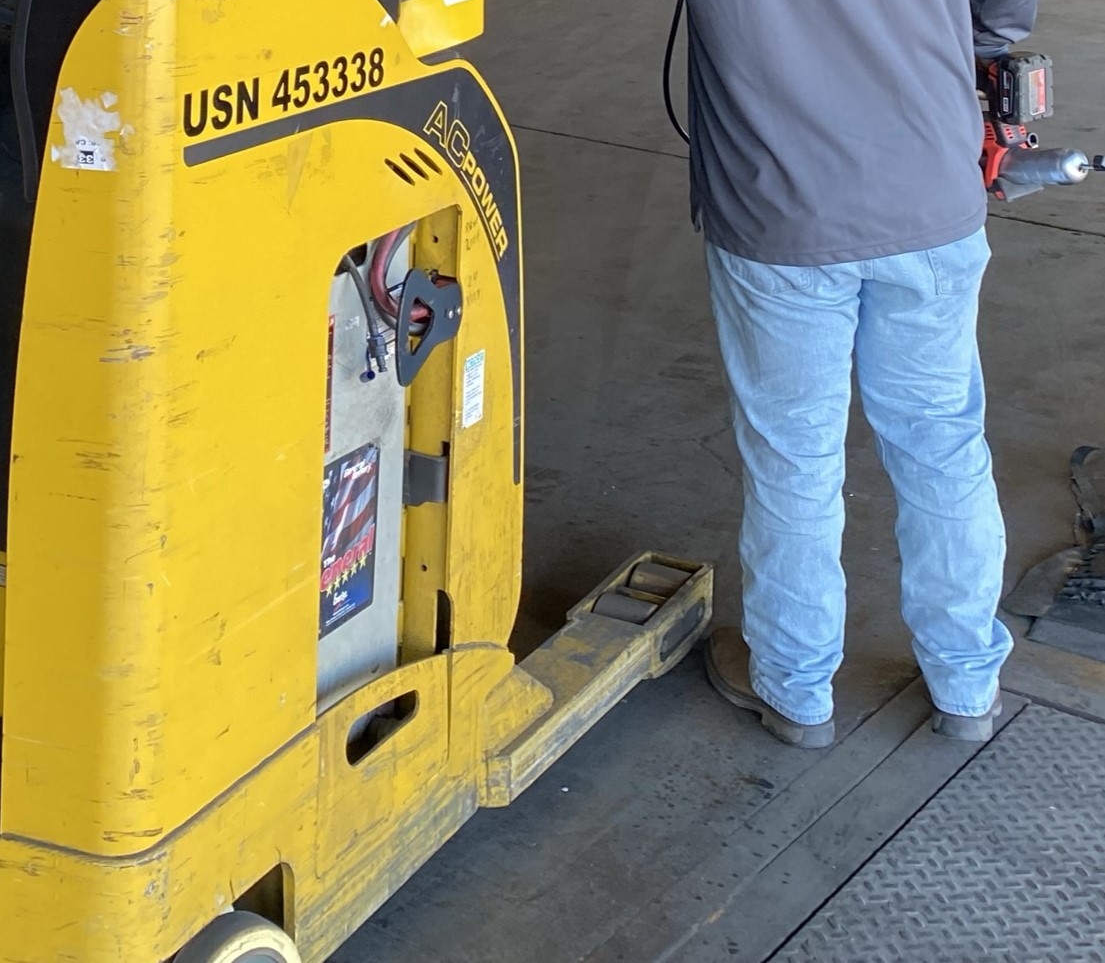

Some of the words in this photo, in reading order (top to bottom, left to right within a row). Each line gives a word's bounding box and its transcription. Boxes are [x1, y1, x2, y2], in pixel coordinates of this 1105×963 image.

[183, 77, 260, 138] USN
[271, 47, 384, 113] 453338
[462, 149, 509, 258] POWER
